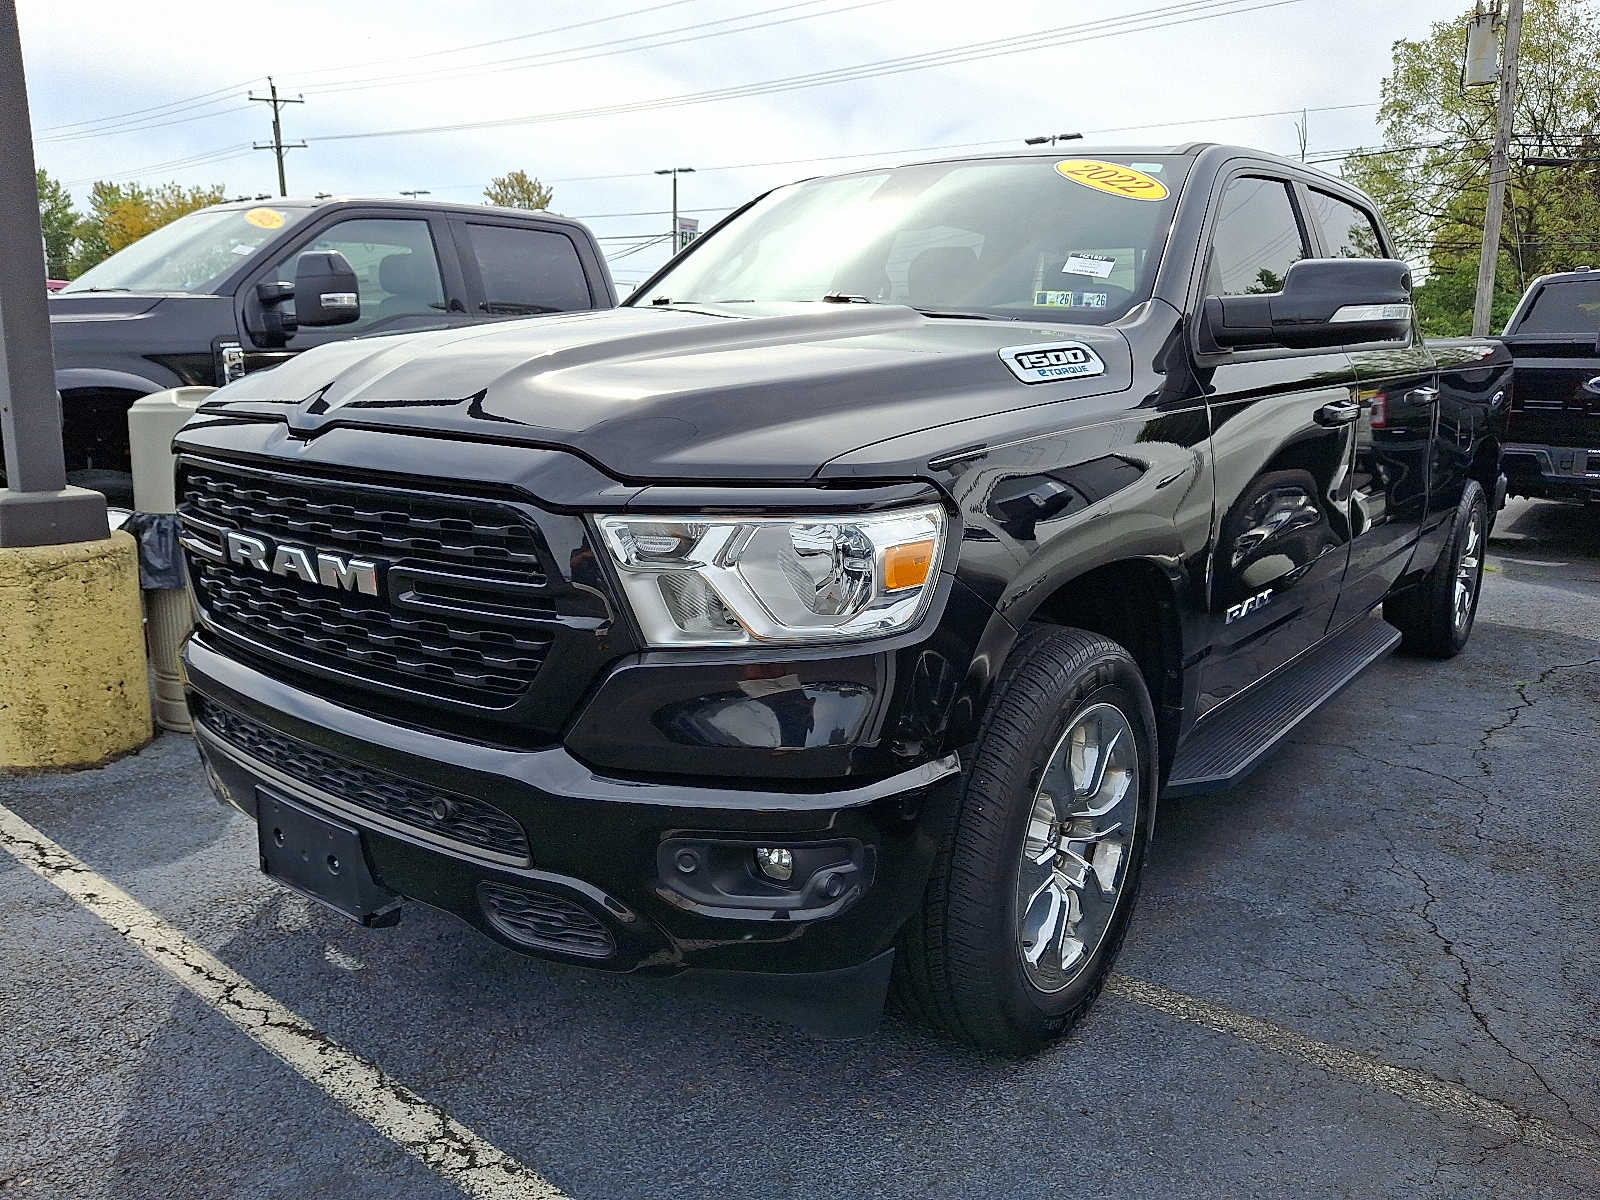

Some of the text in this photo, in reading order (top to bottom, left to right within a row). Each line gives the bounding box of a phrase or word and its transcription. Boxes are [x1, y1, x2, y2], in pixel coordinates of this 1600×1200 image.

[1067, 164, 1155, 193] 2022
[1016, 349, 1086, 369] 1500
[228, 532, 378, 596] RAM
